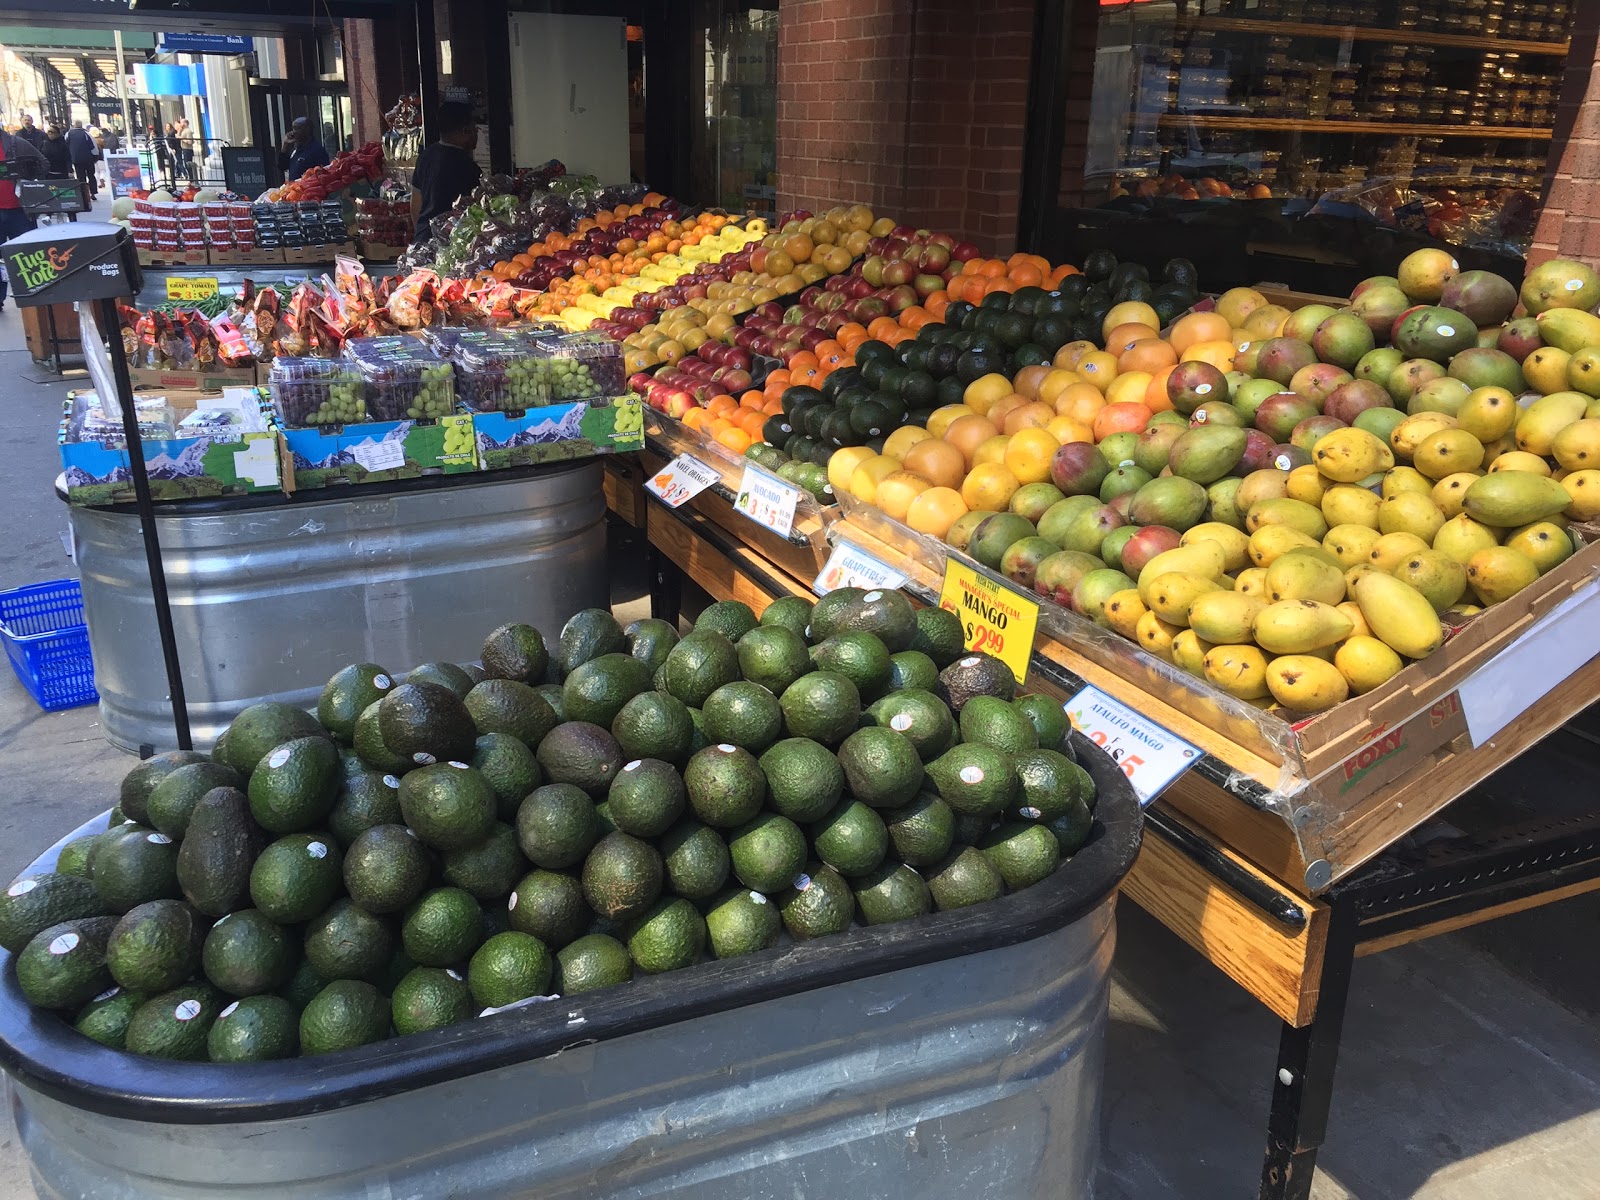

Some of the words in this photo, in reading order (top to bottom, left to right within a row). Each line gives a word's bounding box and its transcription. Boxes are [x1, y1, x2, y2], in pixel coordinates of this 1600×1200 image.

[226, 35, 244, 44] Bank
[10, 249, 46, 272] Tug
[89, 262, 119, 272] Produce
[17, 260, 58, 289] Tote
[102, 268, 120, 277] Bags
[660, 482, 677, 499] 3
[754, 484, 780, 504] AVOCADO
[750, 499, 758, 515] 3
[960, 578, 992, 604] MANAGER'S
[993, 598, 1022, 621] SPECIAL
[962, 590, 1008, 630] MANGO
[1089, 704, 1130, 730] ATAULFO
[1129, 727, 1164, 750] MANGO
[1342, 726, 1404, 780] FOXY
